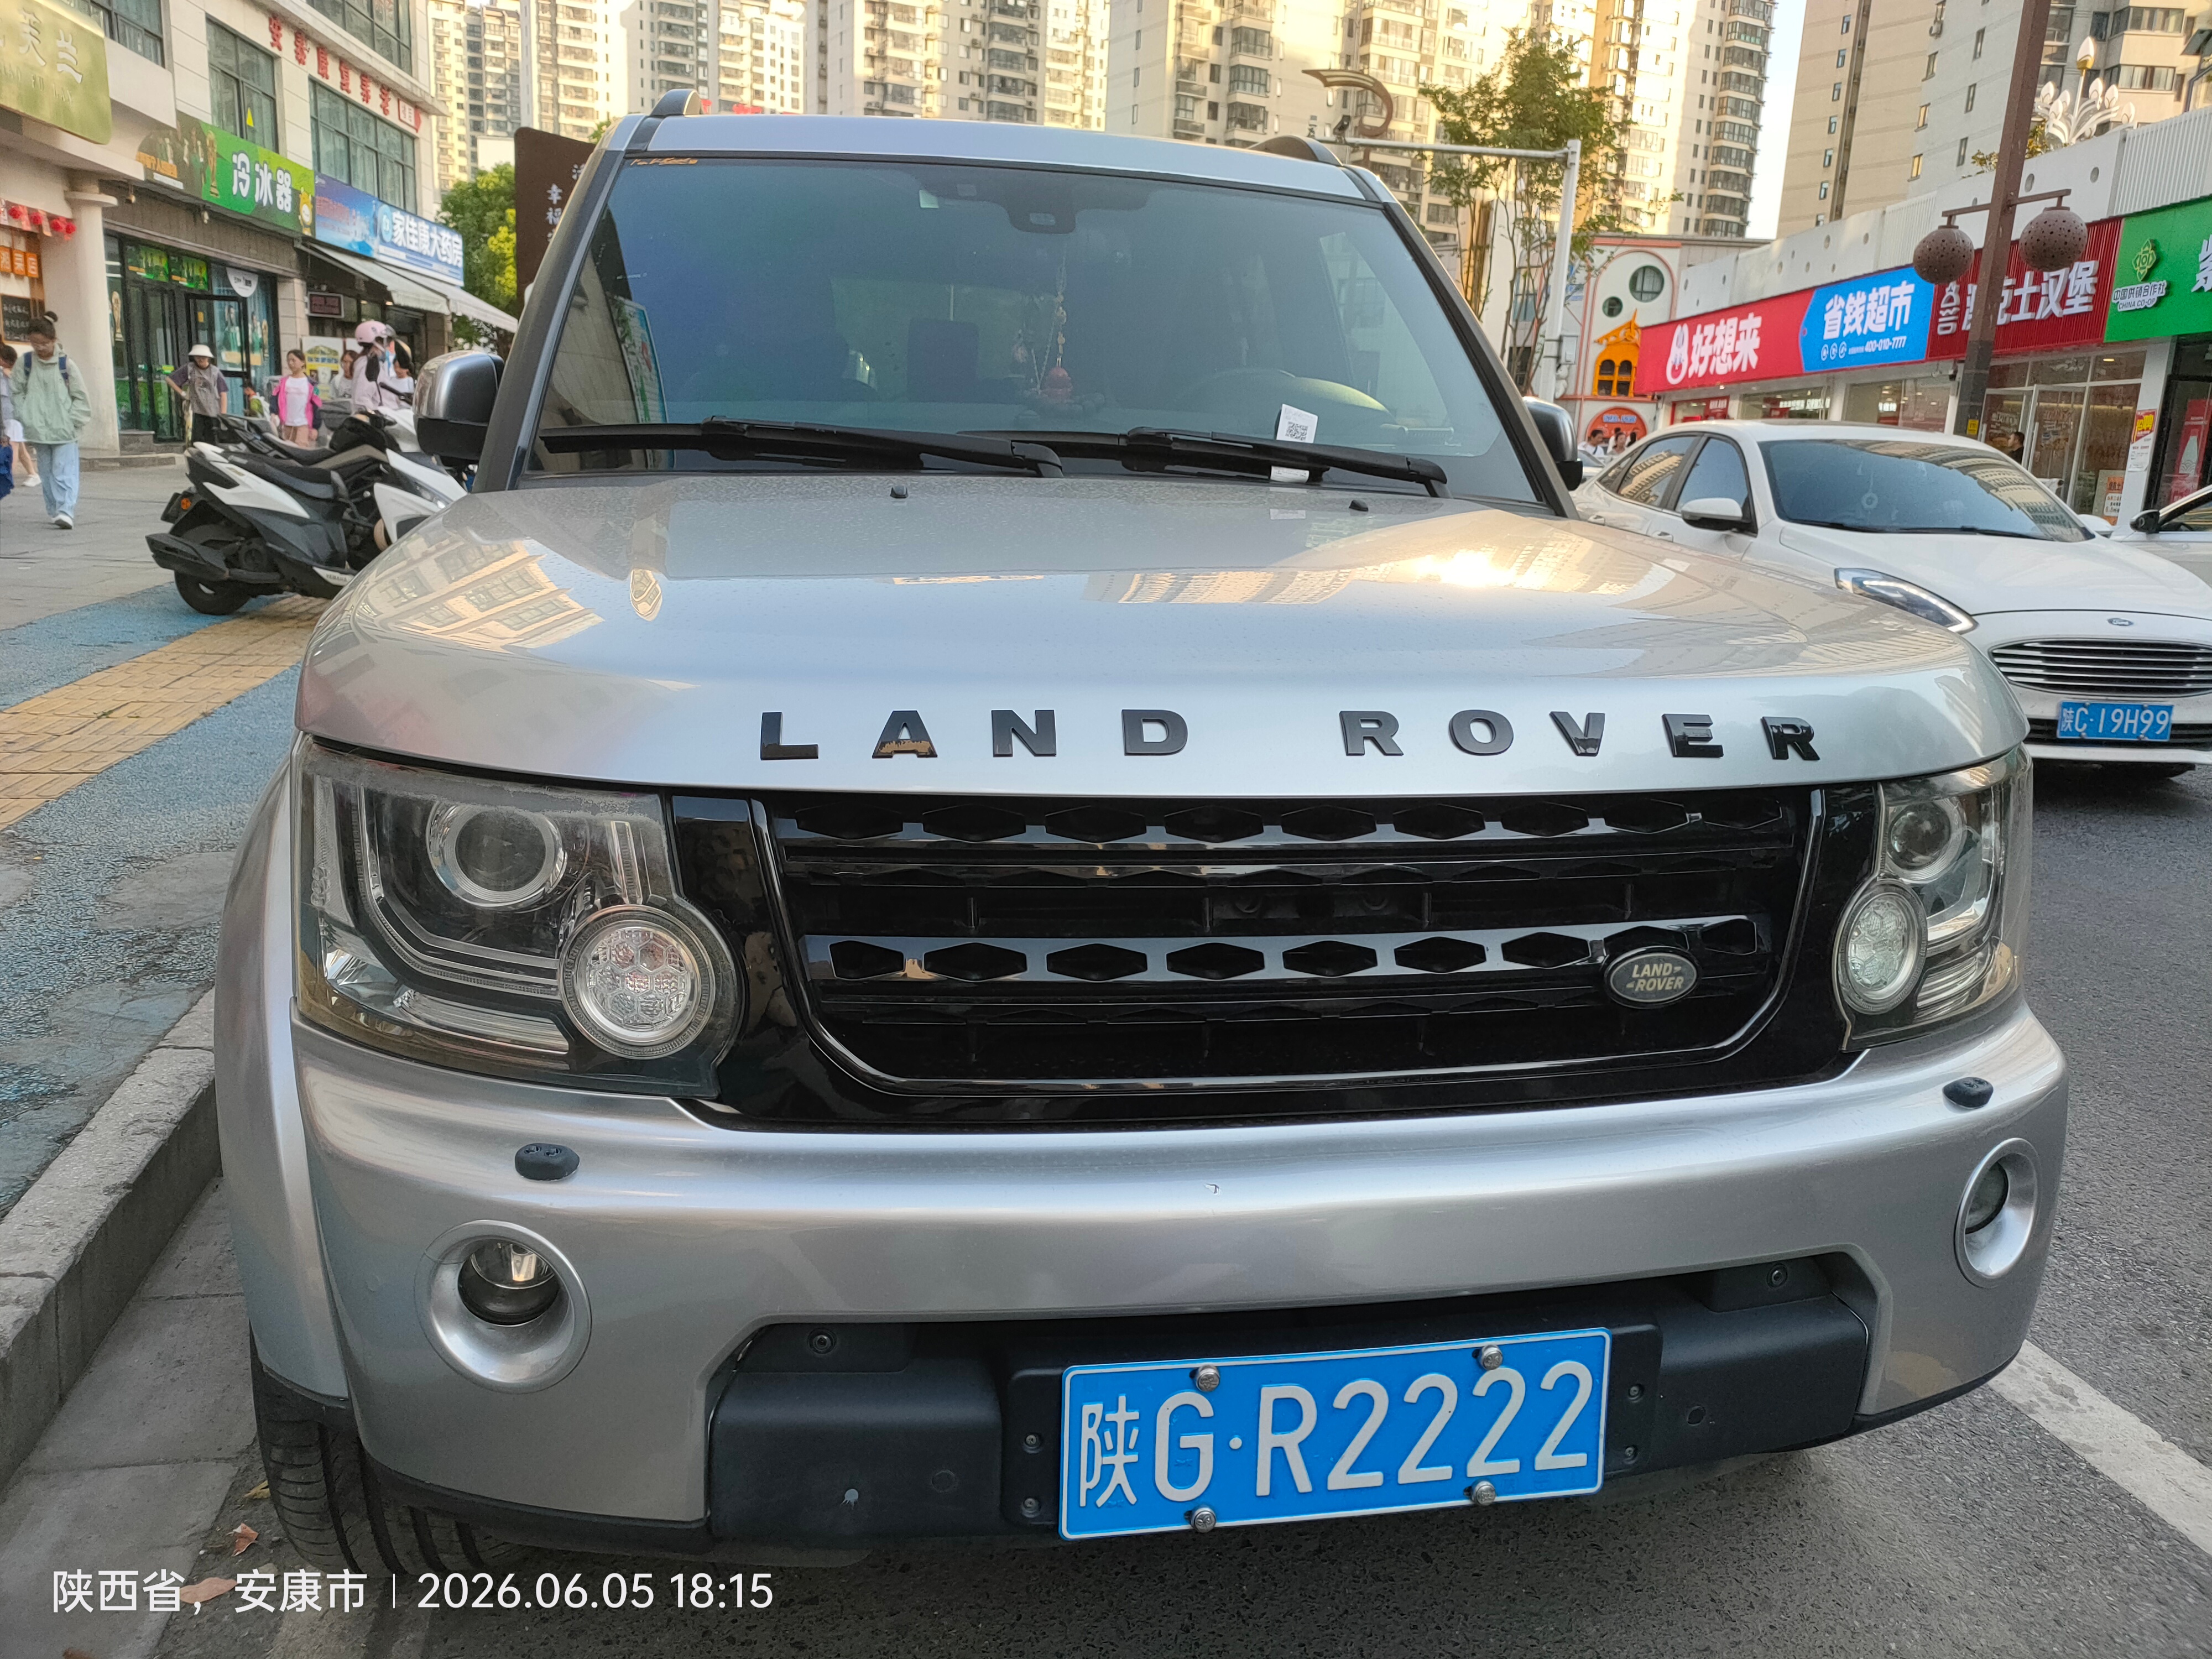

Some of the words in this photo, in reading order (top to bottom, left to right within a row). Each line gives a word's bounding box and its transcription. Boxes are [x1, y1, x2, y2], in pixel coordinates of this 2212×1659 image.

[232, 153, 291, 213] 冷冰器
[393, 211, 463, 268] 家佳康大药房
[2113, 282, 2166, 301] 中国供销合作社
[2119, 301, 2136, 310] CHINA
[2137, 298, 2156, 306] CO-OP
[1823, 280, 1915, 340] 省钱超市
[1688, 312, 1762, 379] 好想来
[1865, 336, 1907, 352] 400-010-7777
[760, 709, 1188, 760] LAND
[1339, 709, 1820, 761] ROVER
[1632, 963, 1673, 978] LAND
[1635, 976, 1684, 992] ROVER
